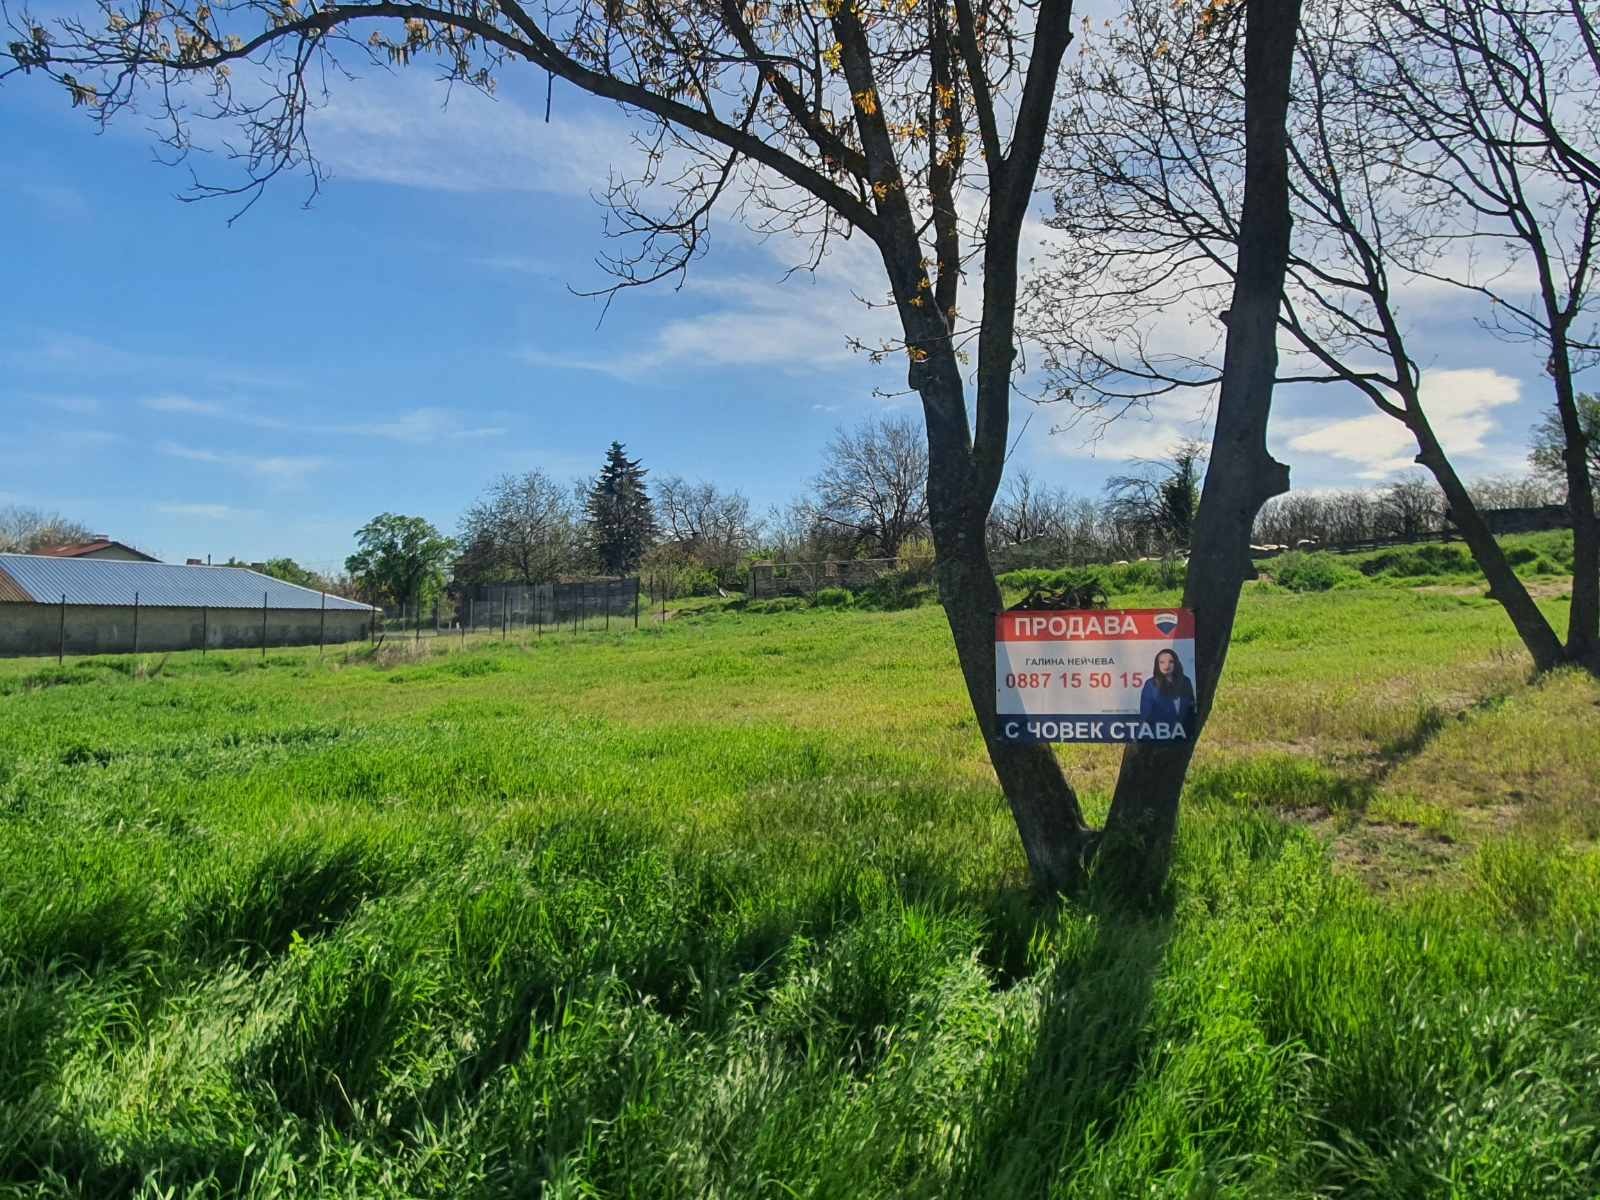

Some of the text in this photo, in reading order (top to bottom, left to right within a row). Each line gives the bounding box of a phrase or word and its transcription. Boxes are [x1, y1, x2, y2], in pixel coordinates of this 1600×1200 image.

[1015, 616, 1138, 638] ПРОДАВА
[1025, 657, 1065, 666] ГАЛИНА
[1006, 672, 1142, 688] 0887 15 50 15
[1005, 722, 1186, 739] С ЧОВЕК СТАВА
